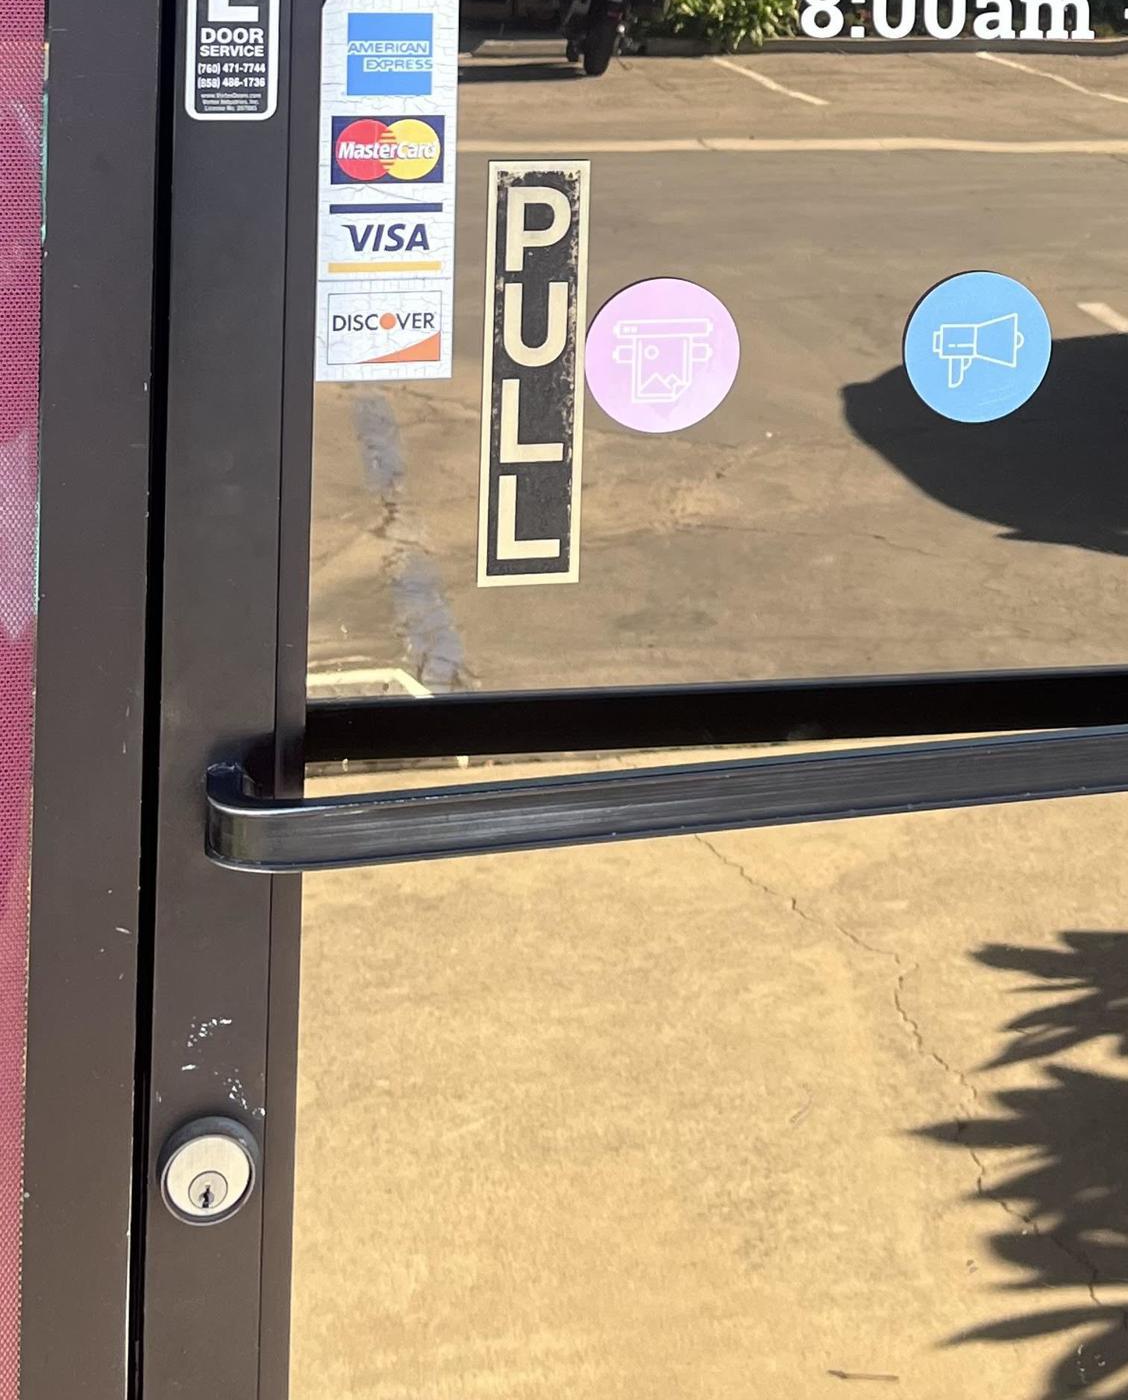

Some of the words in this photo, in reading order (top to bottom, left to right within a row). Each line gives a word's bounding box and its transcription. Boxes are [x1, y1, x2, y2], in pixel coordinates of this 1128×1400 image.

[200, 27, 264, 44] DOOR
[199, 45, 265, 57] SERVICE
[347, 42, 428, 53] AMERICAN
[365, 59, 433, 70] EXPRESS
[338, 140, 436, 160] MasterCard
[341, 223, 431, 252] VISA
[332, 312, 436, 332] DISCOVER
[495, 185, 573, 561] PULL
